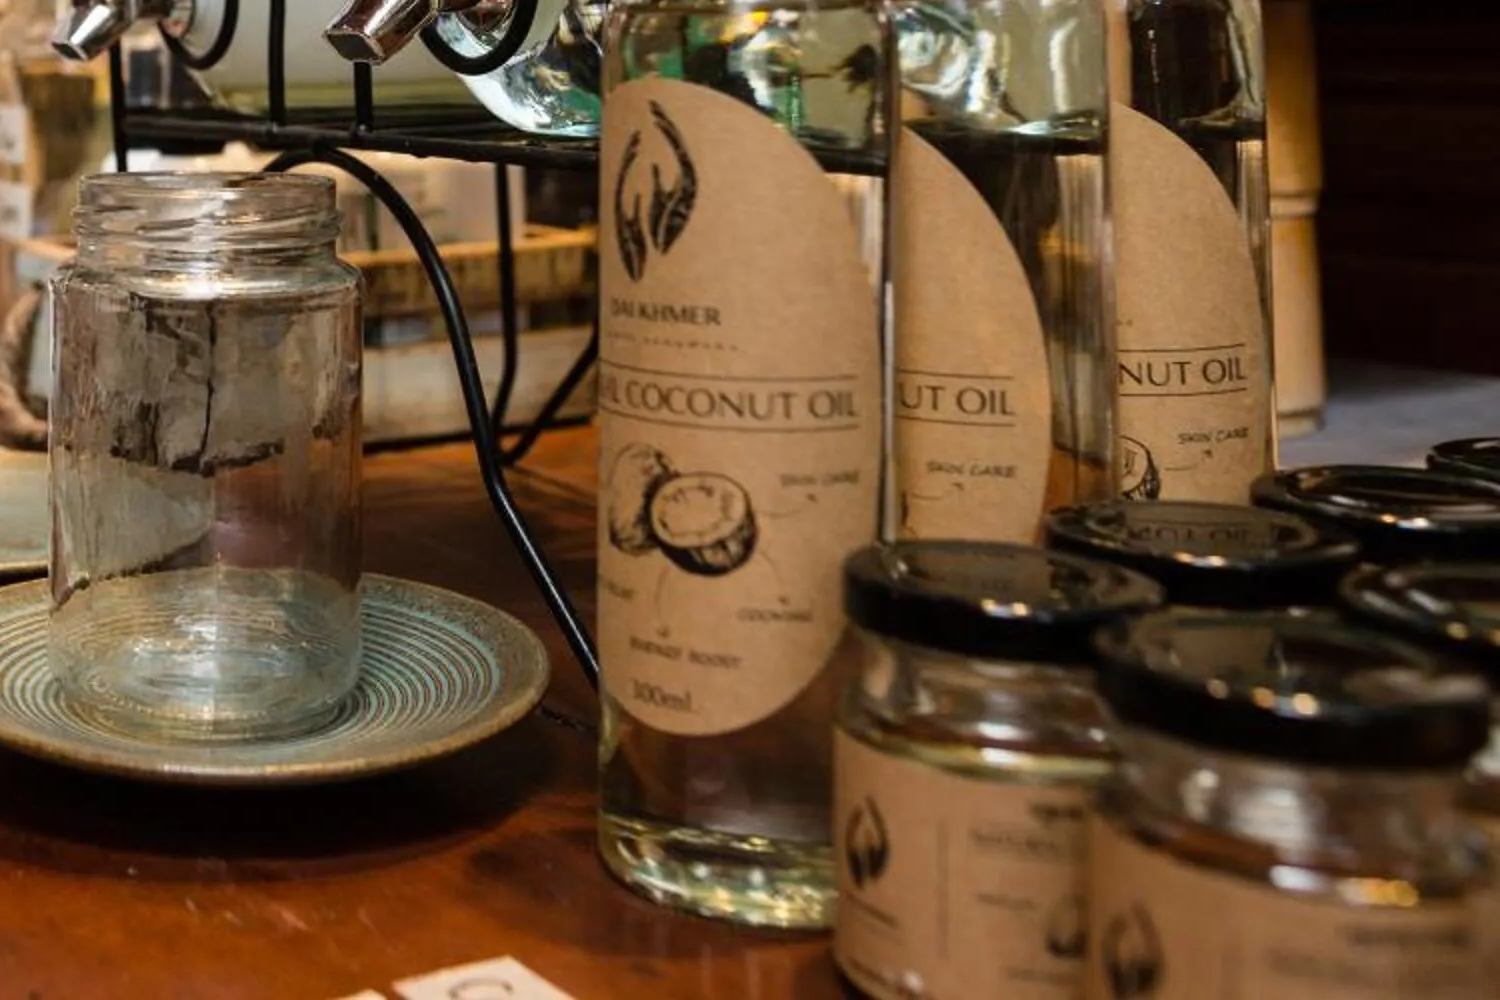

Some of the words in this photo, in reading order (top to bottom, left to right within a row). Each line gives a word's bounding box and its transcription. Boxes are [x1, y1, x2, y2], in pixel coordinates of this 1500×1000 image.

[1202, 356, 1248, 384] OIL
[626, 382, 798, 421] COCONUT
[807, 389, 858, 419] OIL
[955, 386, 1016, 416] OIL
[1178, 431, 1211, 444] SKIN
[1215, 426, 1249, 443] CARE
